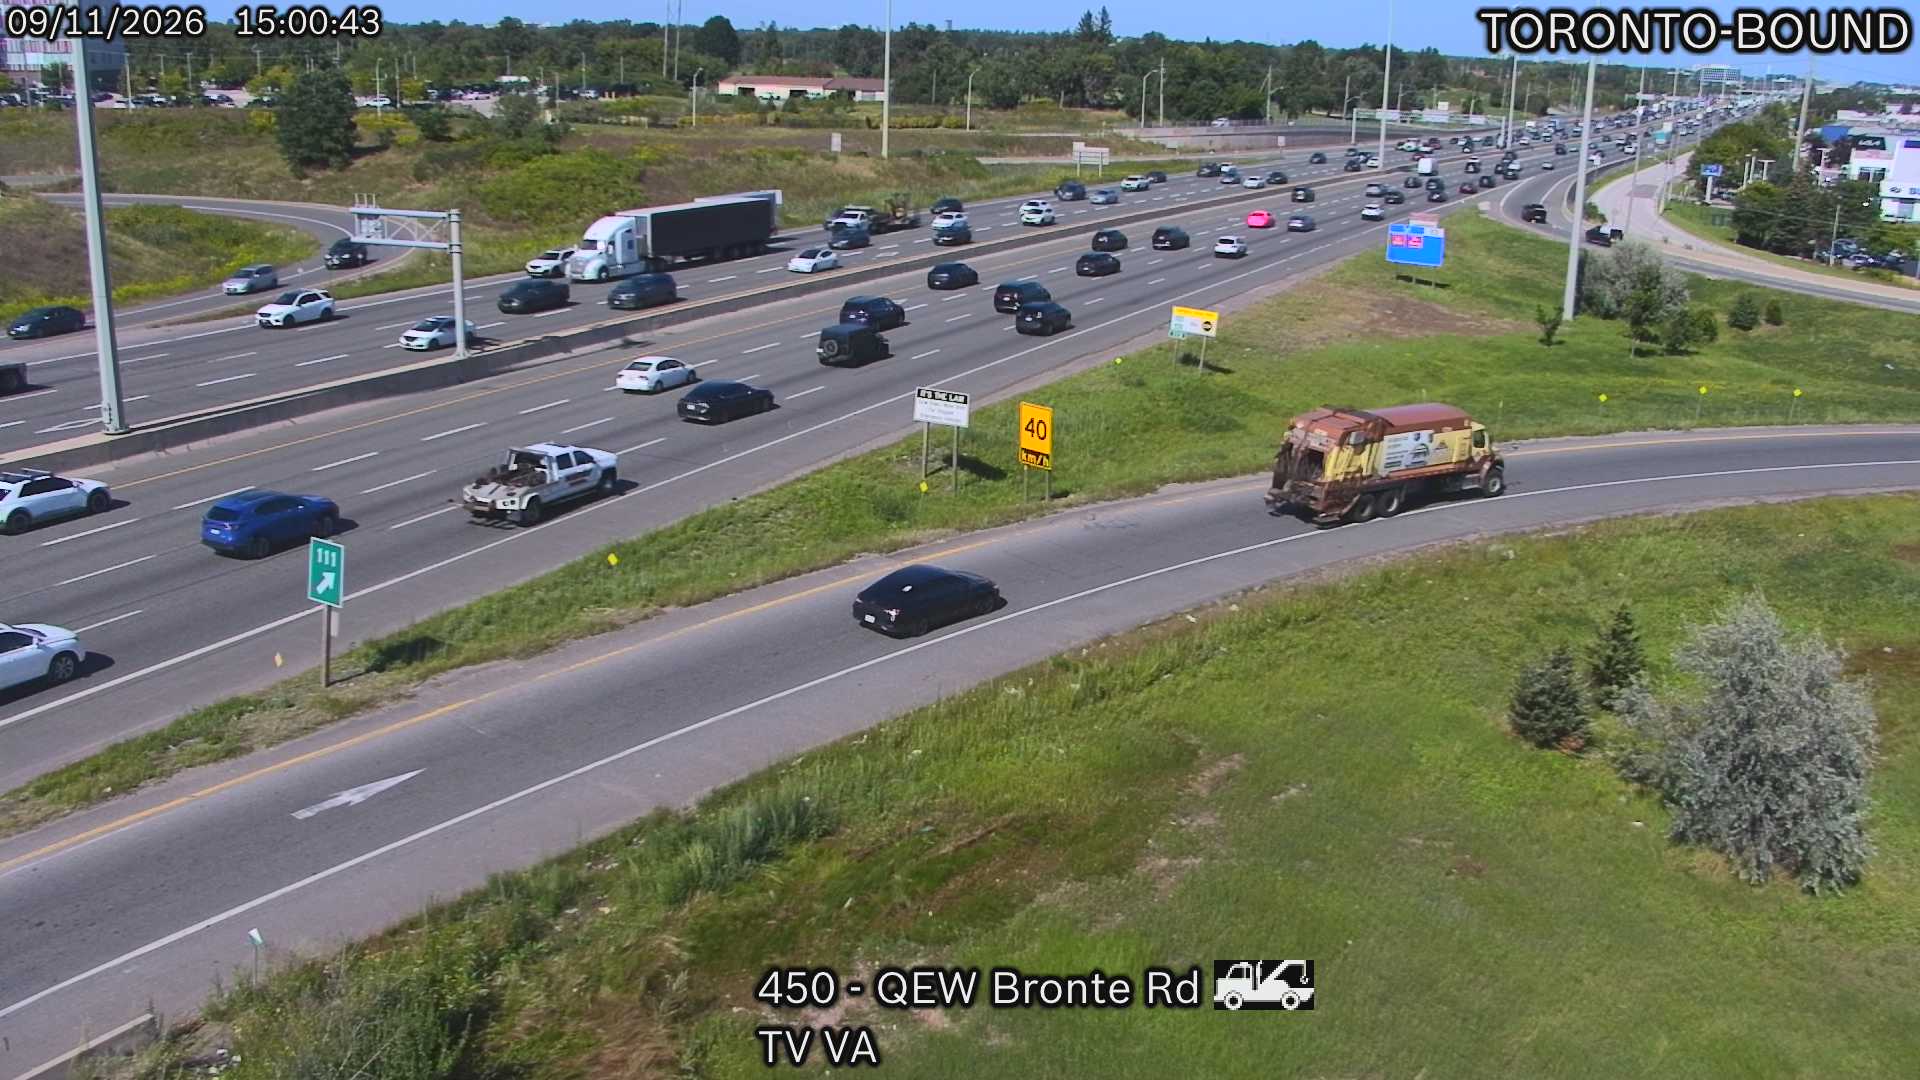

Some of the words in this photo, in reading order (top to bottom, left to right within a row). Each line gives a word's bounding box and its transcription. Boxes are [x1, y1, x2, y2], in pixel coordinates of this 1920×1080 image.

[1024, 417, 1047, 441] 40
[1021, 450, 1050, 467] km/h
[316, 547, 337, 568] 111
